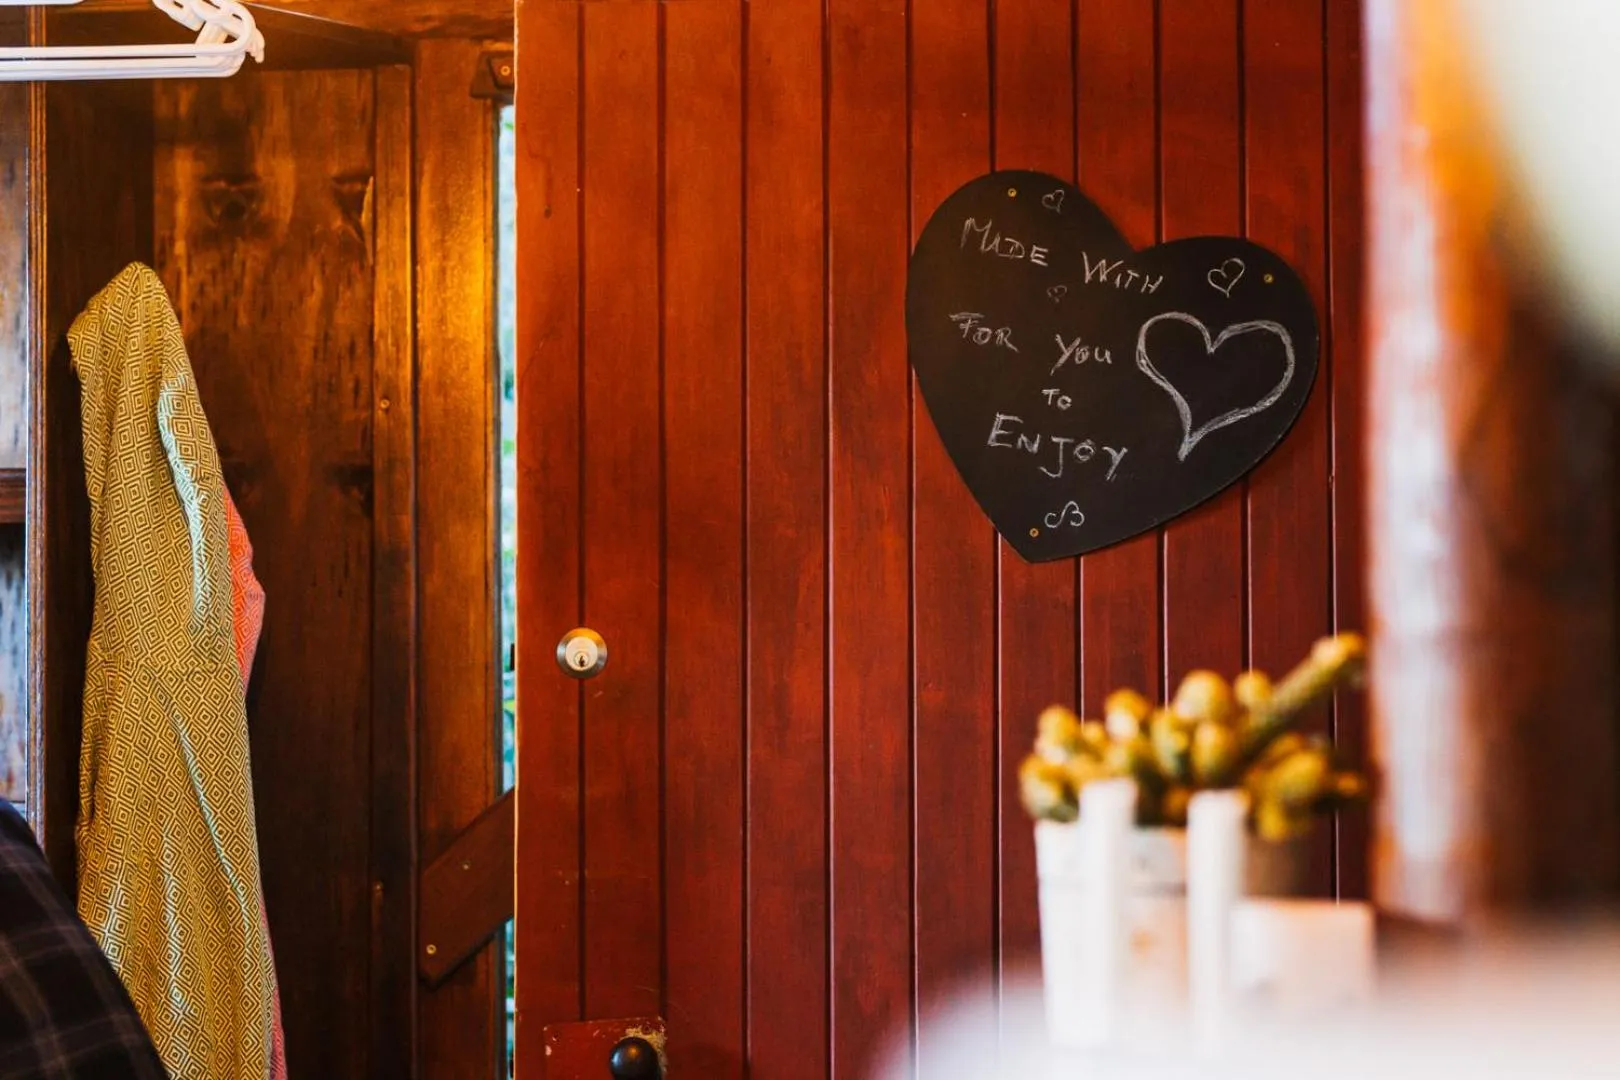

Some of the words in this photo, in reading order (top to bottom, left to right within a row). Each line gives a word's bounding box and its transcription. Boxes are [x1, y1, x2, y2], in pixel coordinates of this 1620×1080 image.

[960, 217, 1049, 266] MADE
[1081, 251, 1163, 294] WITH
[949, 312, 1020, 353] FOR
[986, 412, 1128, 481] ENJOY
